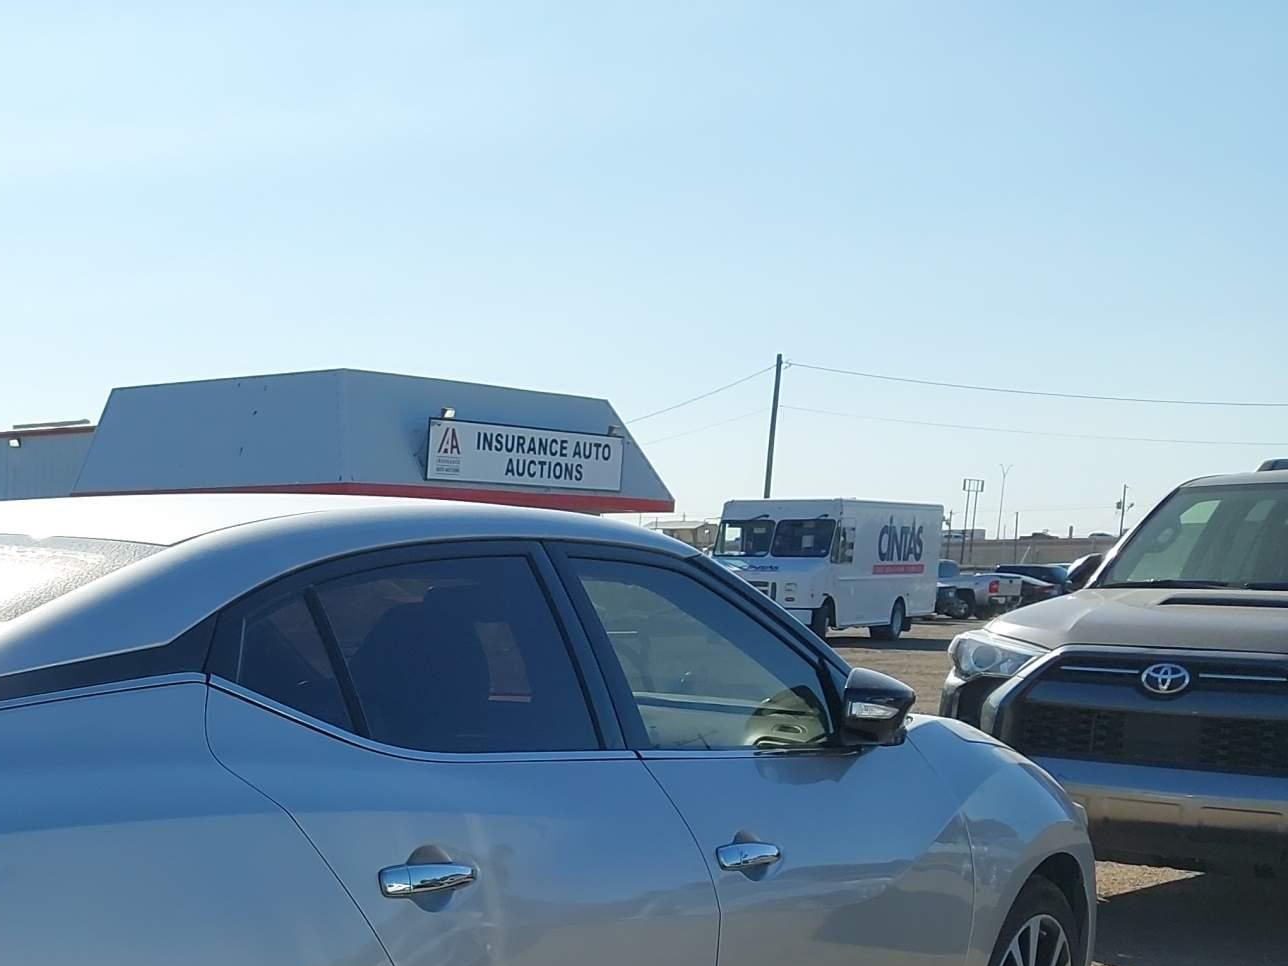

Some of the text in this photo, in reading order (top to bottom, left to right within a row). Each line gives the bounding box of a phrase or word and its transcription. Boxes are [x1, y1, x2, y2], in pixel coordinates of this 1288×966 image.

[476, 431, 611, 461] INSURANCE AUTO
[505, 458, 583, 481] AUCTIONS
[878, 515, 923, 562] CINTAS
